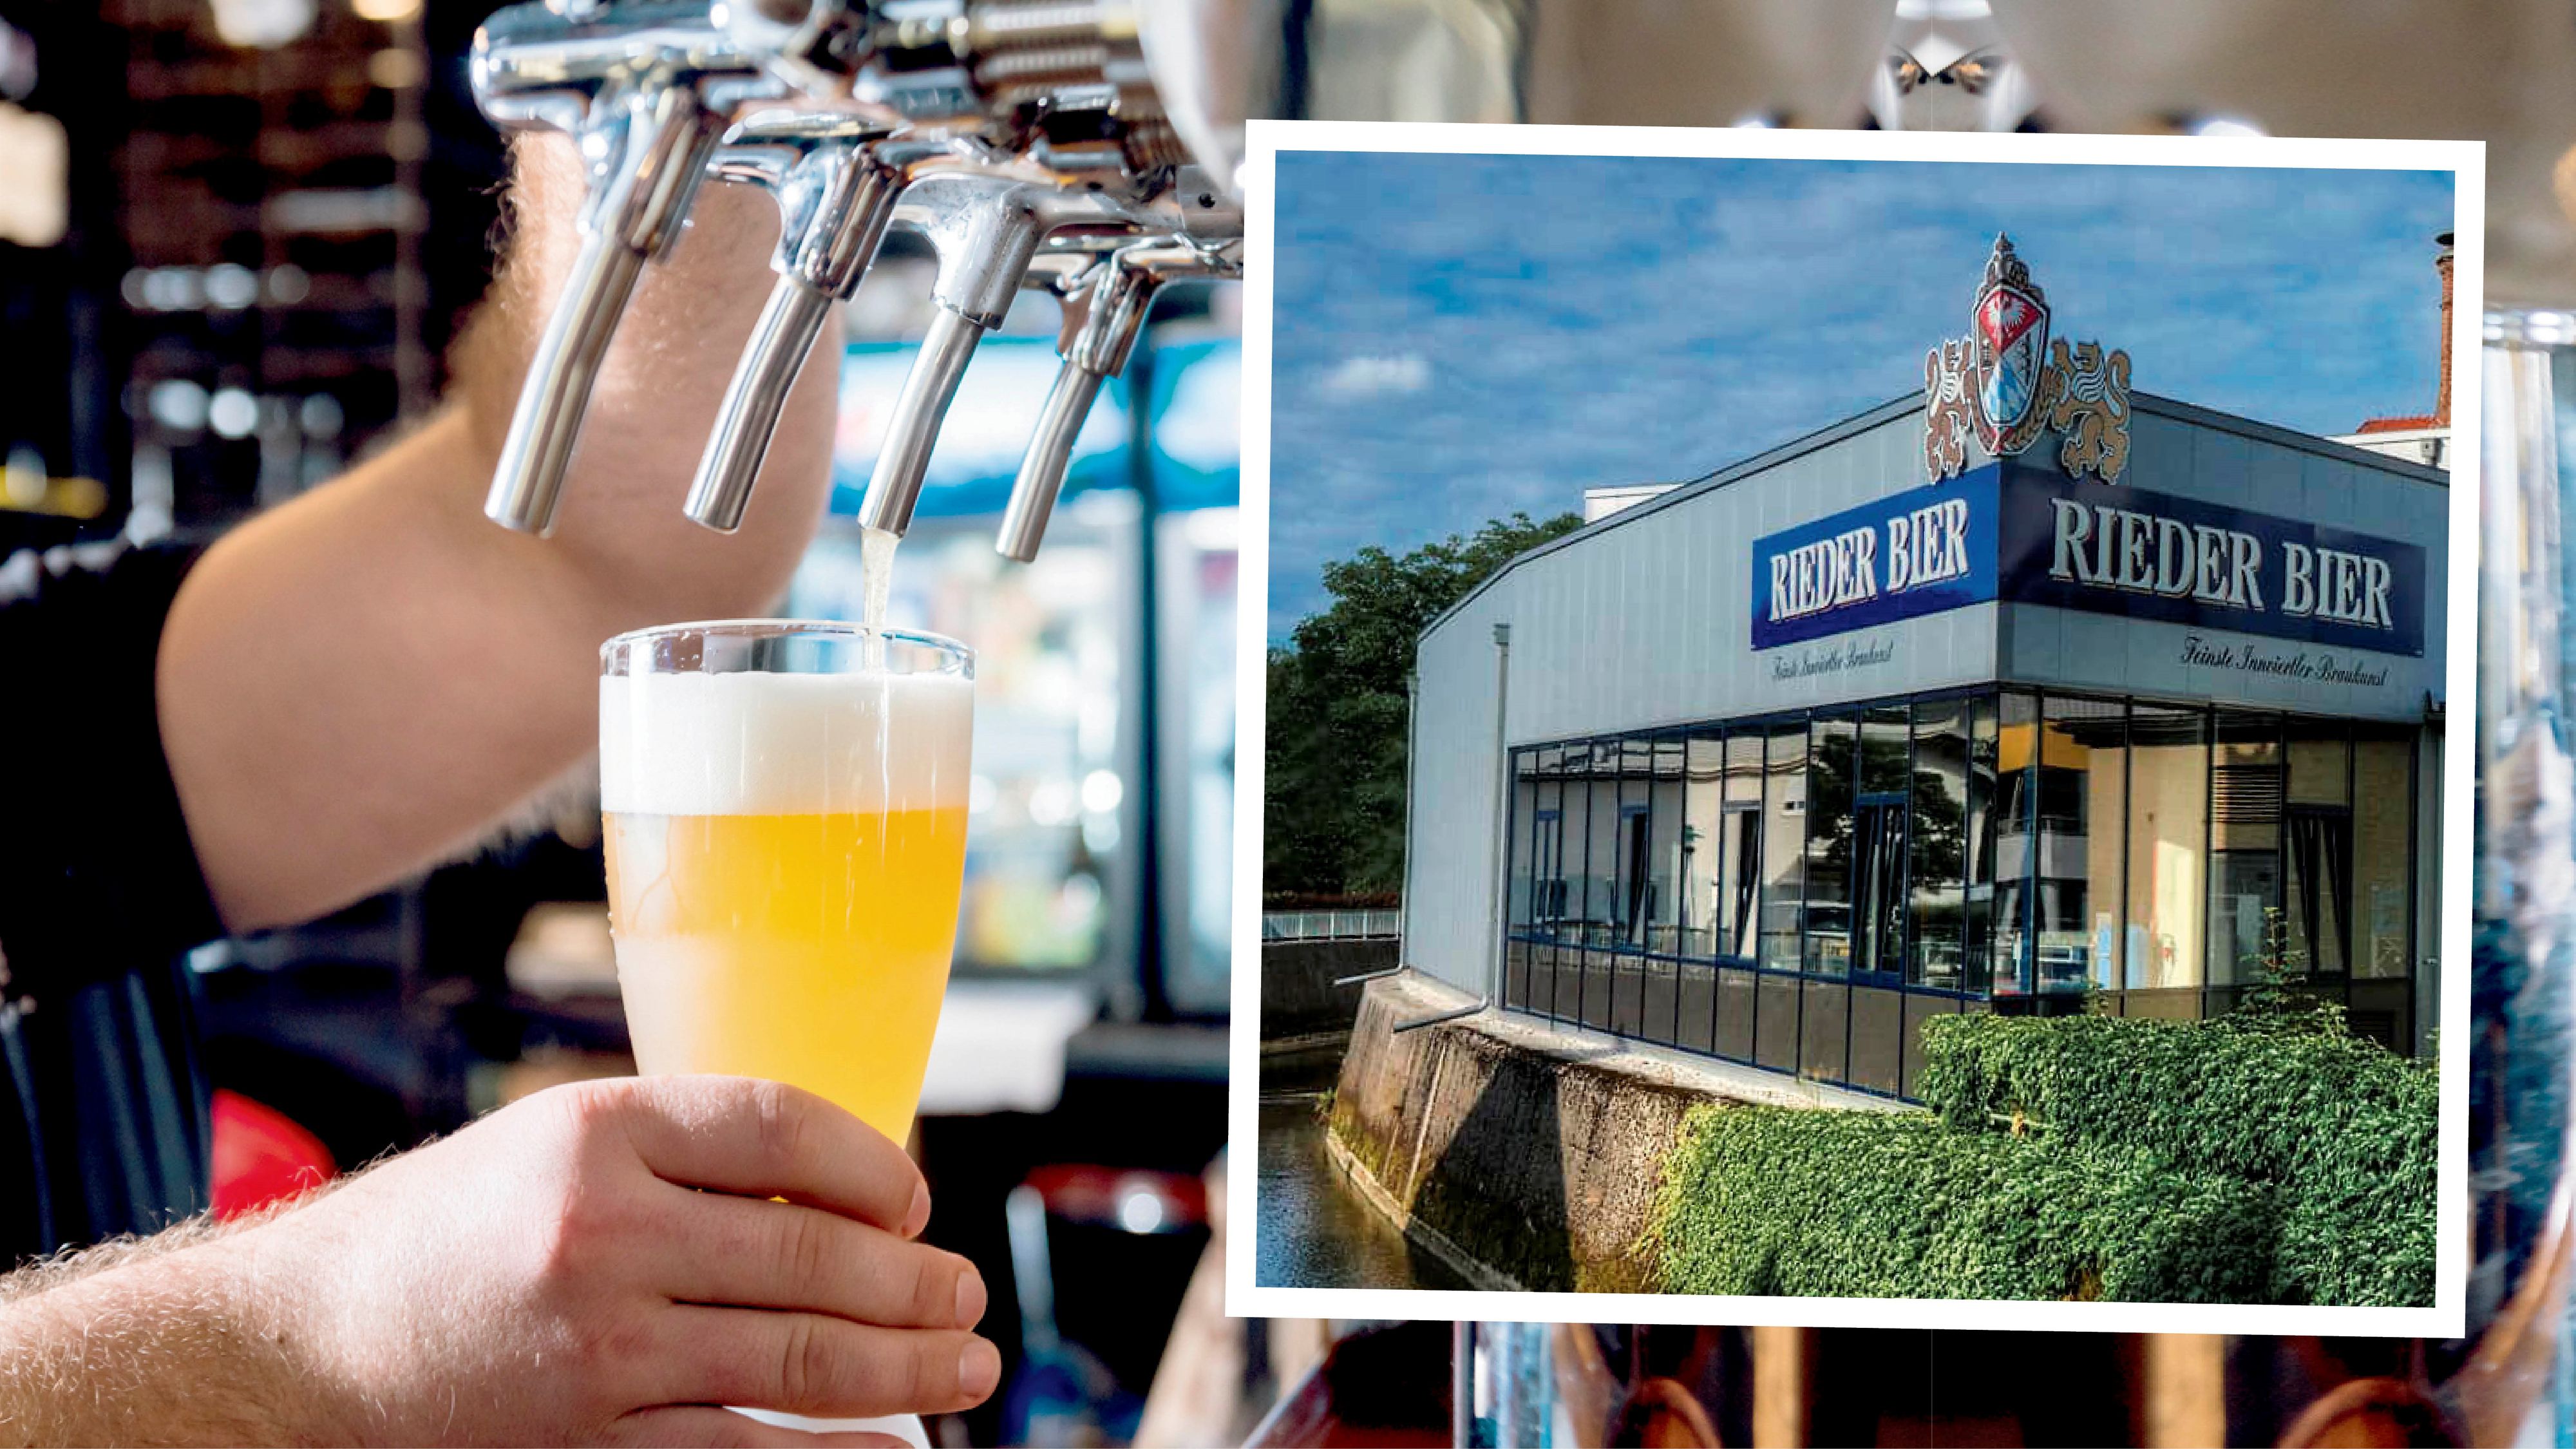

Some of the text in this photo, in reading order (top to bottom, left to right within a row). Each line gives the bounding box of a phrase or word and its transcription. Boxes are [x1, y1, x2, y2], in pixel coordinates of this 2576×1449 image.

[1768, 498, 1971, 623] RIEDER BIER
[2048, 497, 2394, 629] RIEDER BIER
